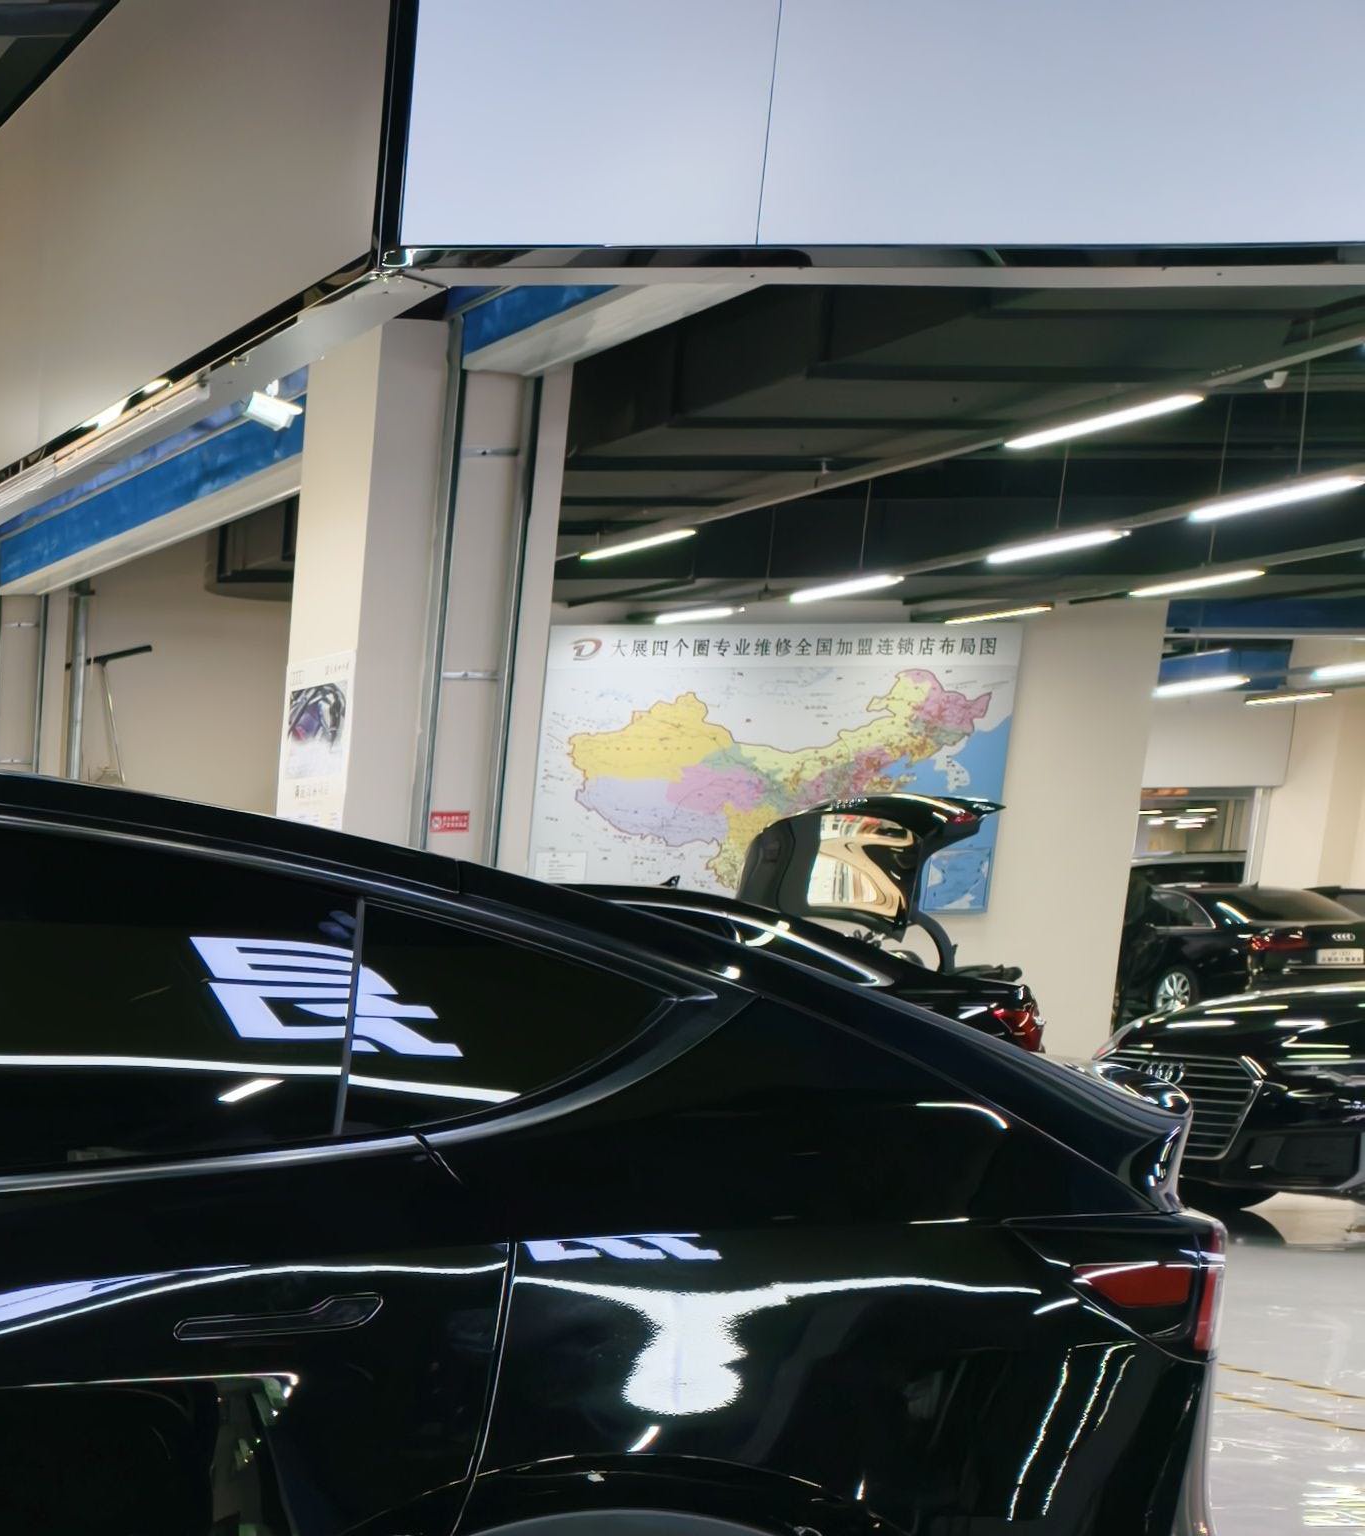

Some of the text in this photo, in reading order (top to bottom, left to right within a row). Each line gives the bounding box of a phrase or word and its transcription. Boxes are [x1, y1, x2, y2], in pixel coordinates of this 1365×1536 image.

[611, 636, 998, 658] 大展四个圈专业维修全国加盟连锁店布局图
